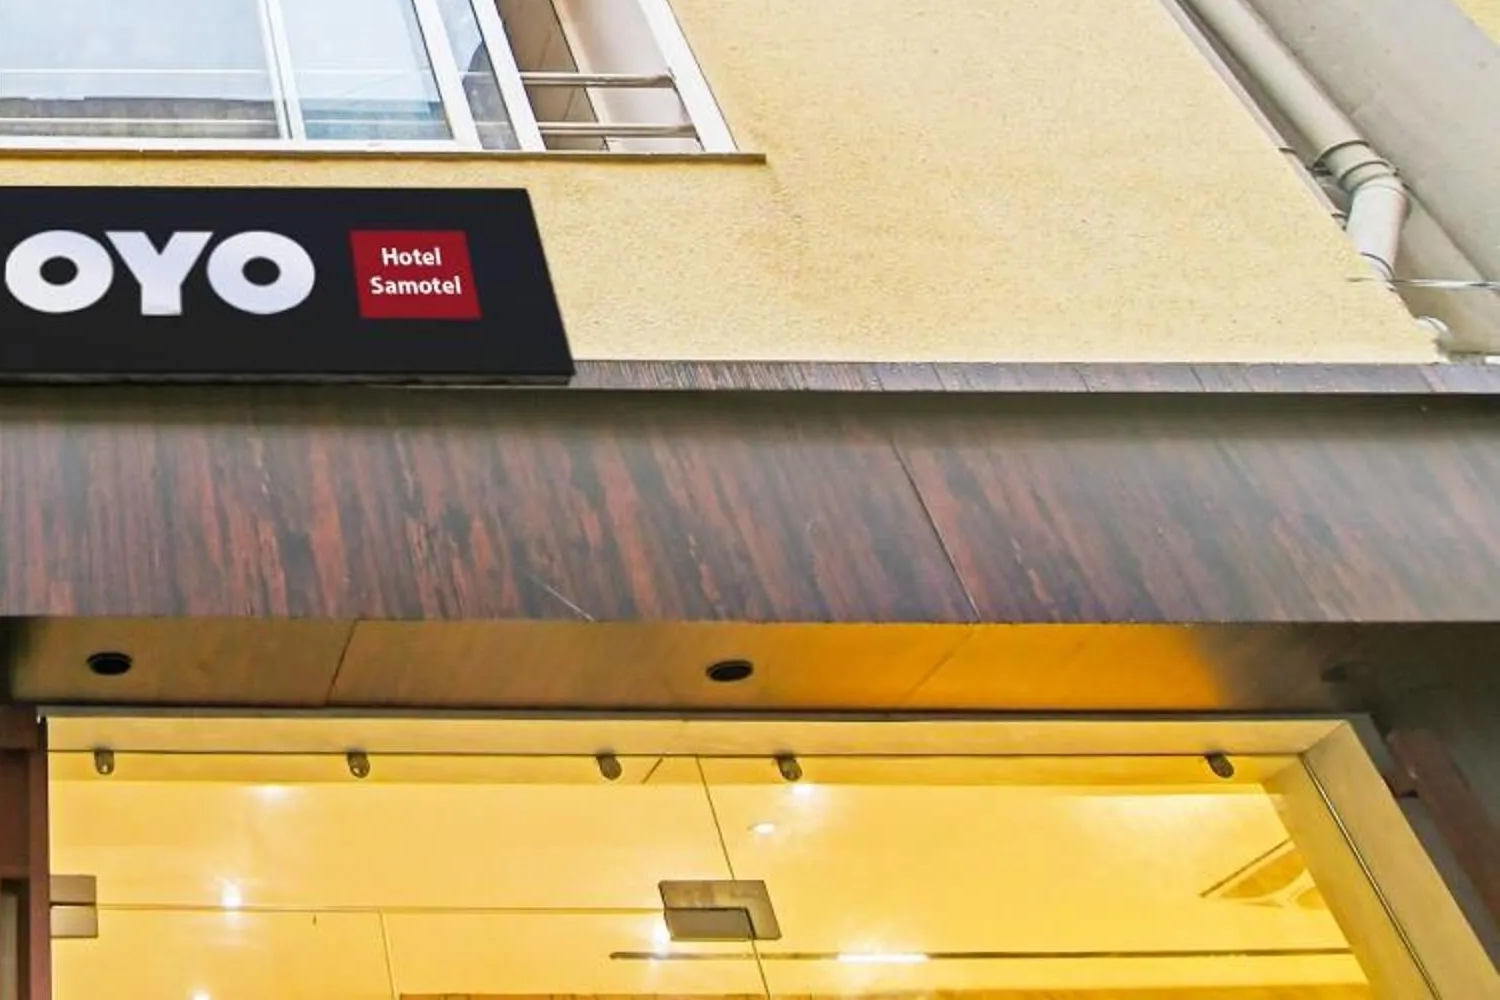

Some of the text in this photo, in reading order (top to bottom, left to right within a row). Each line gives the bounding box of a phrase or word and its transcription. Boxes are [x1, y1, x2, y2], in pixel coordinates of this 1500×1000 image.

[381, 246, 442, 266] Hotel
[5, 229, 315, 316] OYO
[370, 275, 462, 295] Samotel
